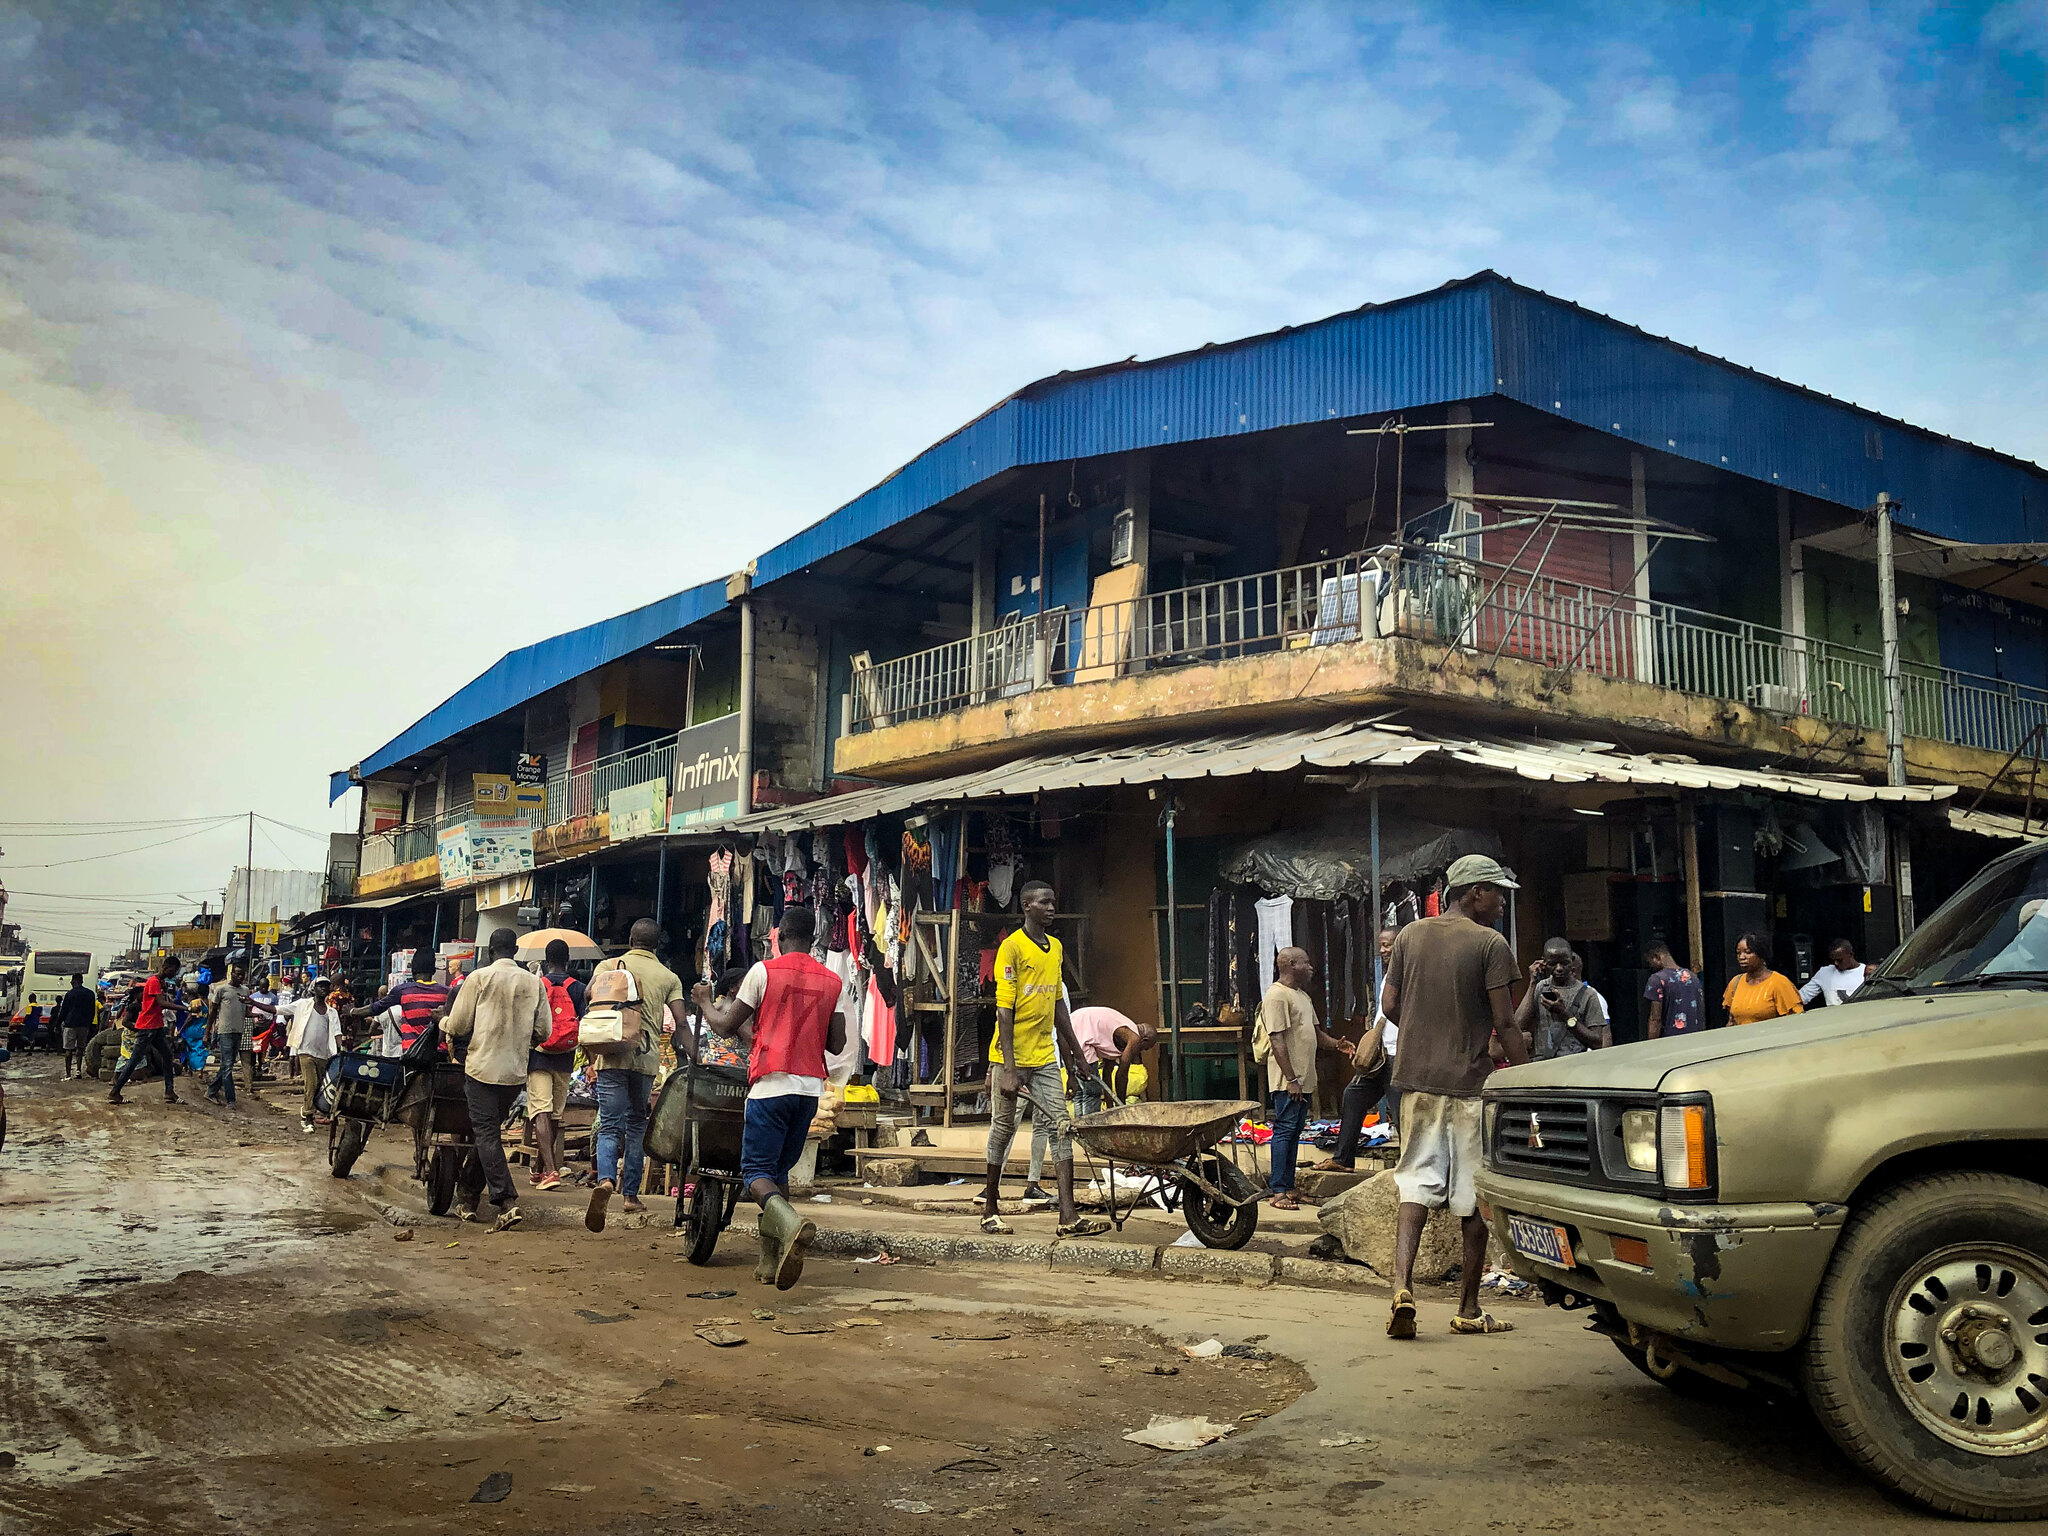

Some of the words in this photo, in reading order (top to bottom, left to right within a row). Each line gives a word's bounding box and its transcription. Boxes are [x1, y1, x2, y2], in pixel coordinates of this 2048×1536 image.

[517, 765, 541, 774] Orange
[678, 747, 740, 792] Infinix
[516, 773, 539, 781] Money
